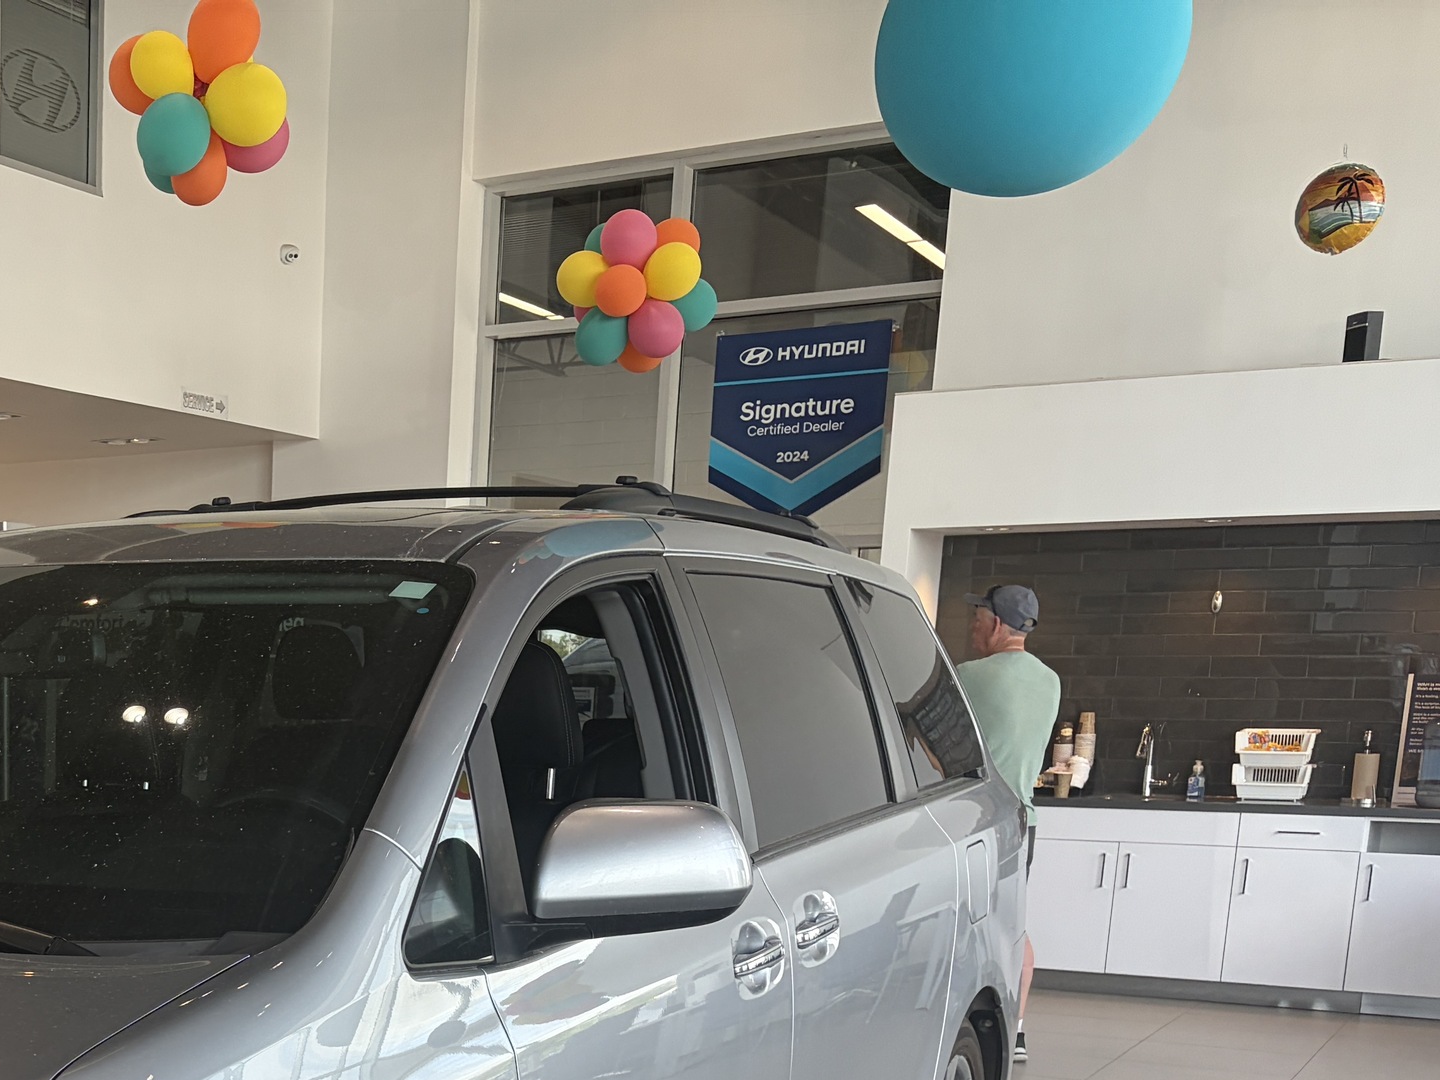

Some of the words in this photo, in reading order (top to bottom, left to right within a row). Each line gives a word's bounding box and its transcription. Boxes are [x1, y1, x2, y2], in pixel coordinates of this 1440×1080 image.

[777, 339, 866, 361] HYUNDAI
[183, 392, 214, 413] SERVICE
[740, 397, 855, 423] Signature
[747, 422, 799, 437] Certified
[803, 420, 845, 433] Dealer
[776, 450, 810, 463] 2024
